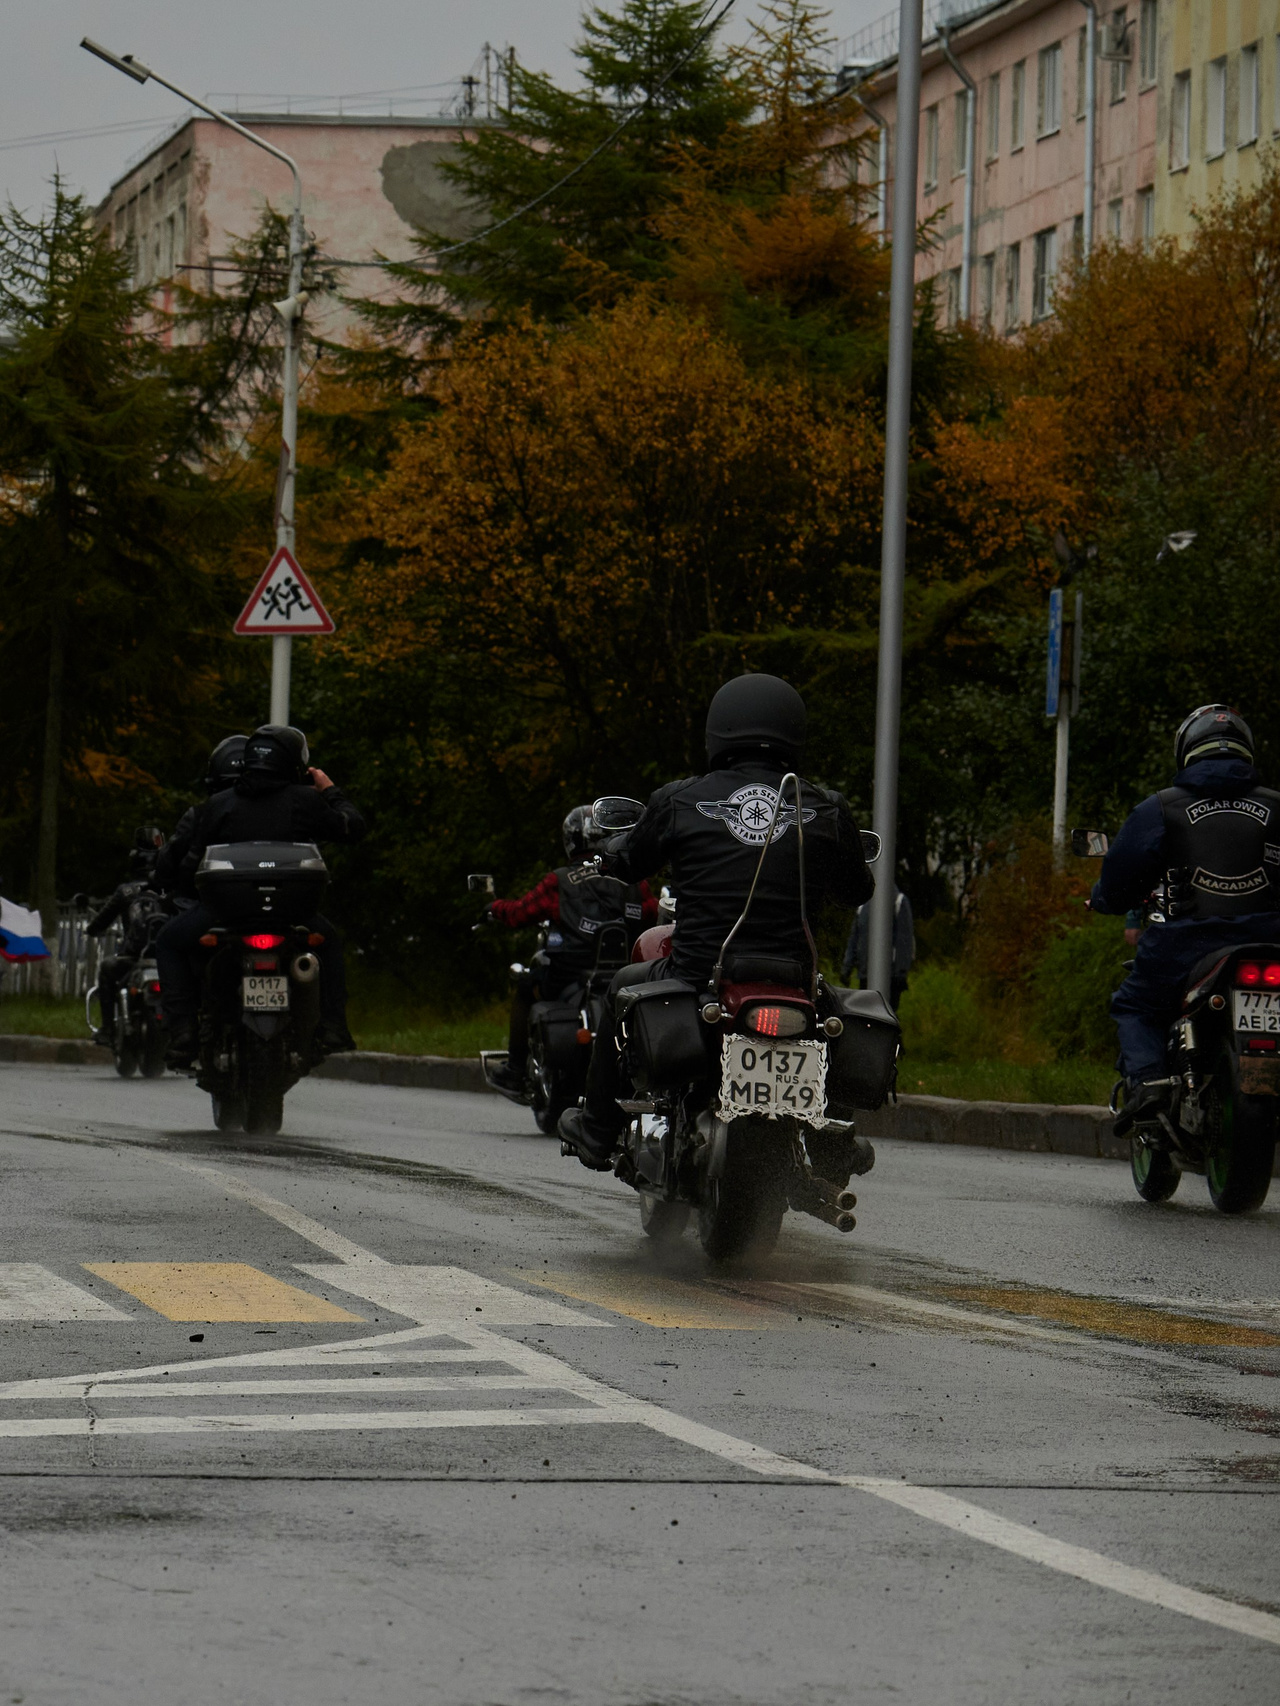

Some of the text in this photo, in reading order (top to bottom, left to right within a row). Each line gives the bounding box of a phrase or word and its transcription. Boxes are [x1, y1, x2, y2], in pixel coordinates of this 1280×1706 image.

[735, 788, 778, 803] Drag Sta
[1191, 800, 1266, 818] POLAR OWLS
[1198, 876, 1264, 890] MAGADAN
[249, 977, 281, 989] 0117
[269, 994, 285, 1005] 49
[1238, 1015, 1261, 1029] AE
[741, 1047, 808, 1075] 0137
[775, 1075, 799, 1085] RUS
[730, 1080, 814, 1109] MB 49
